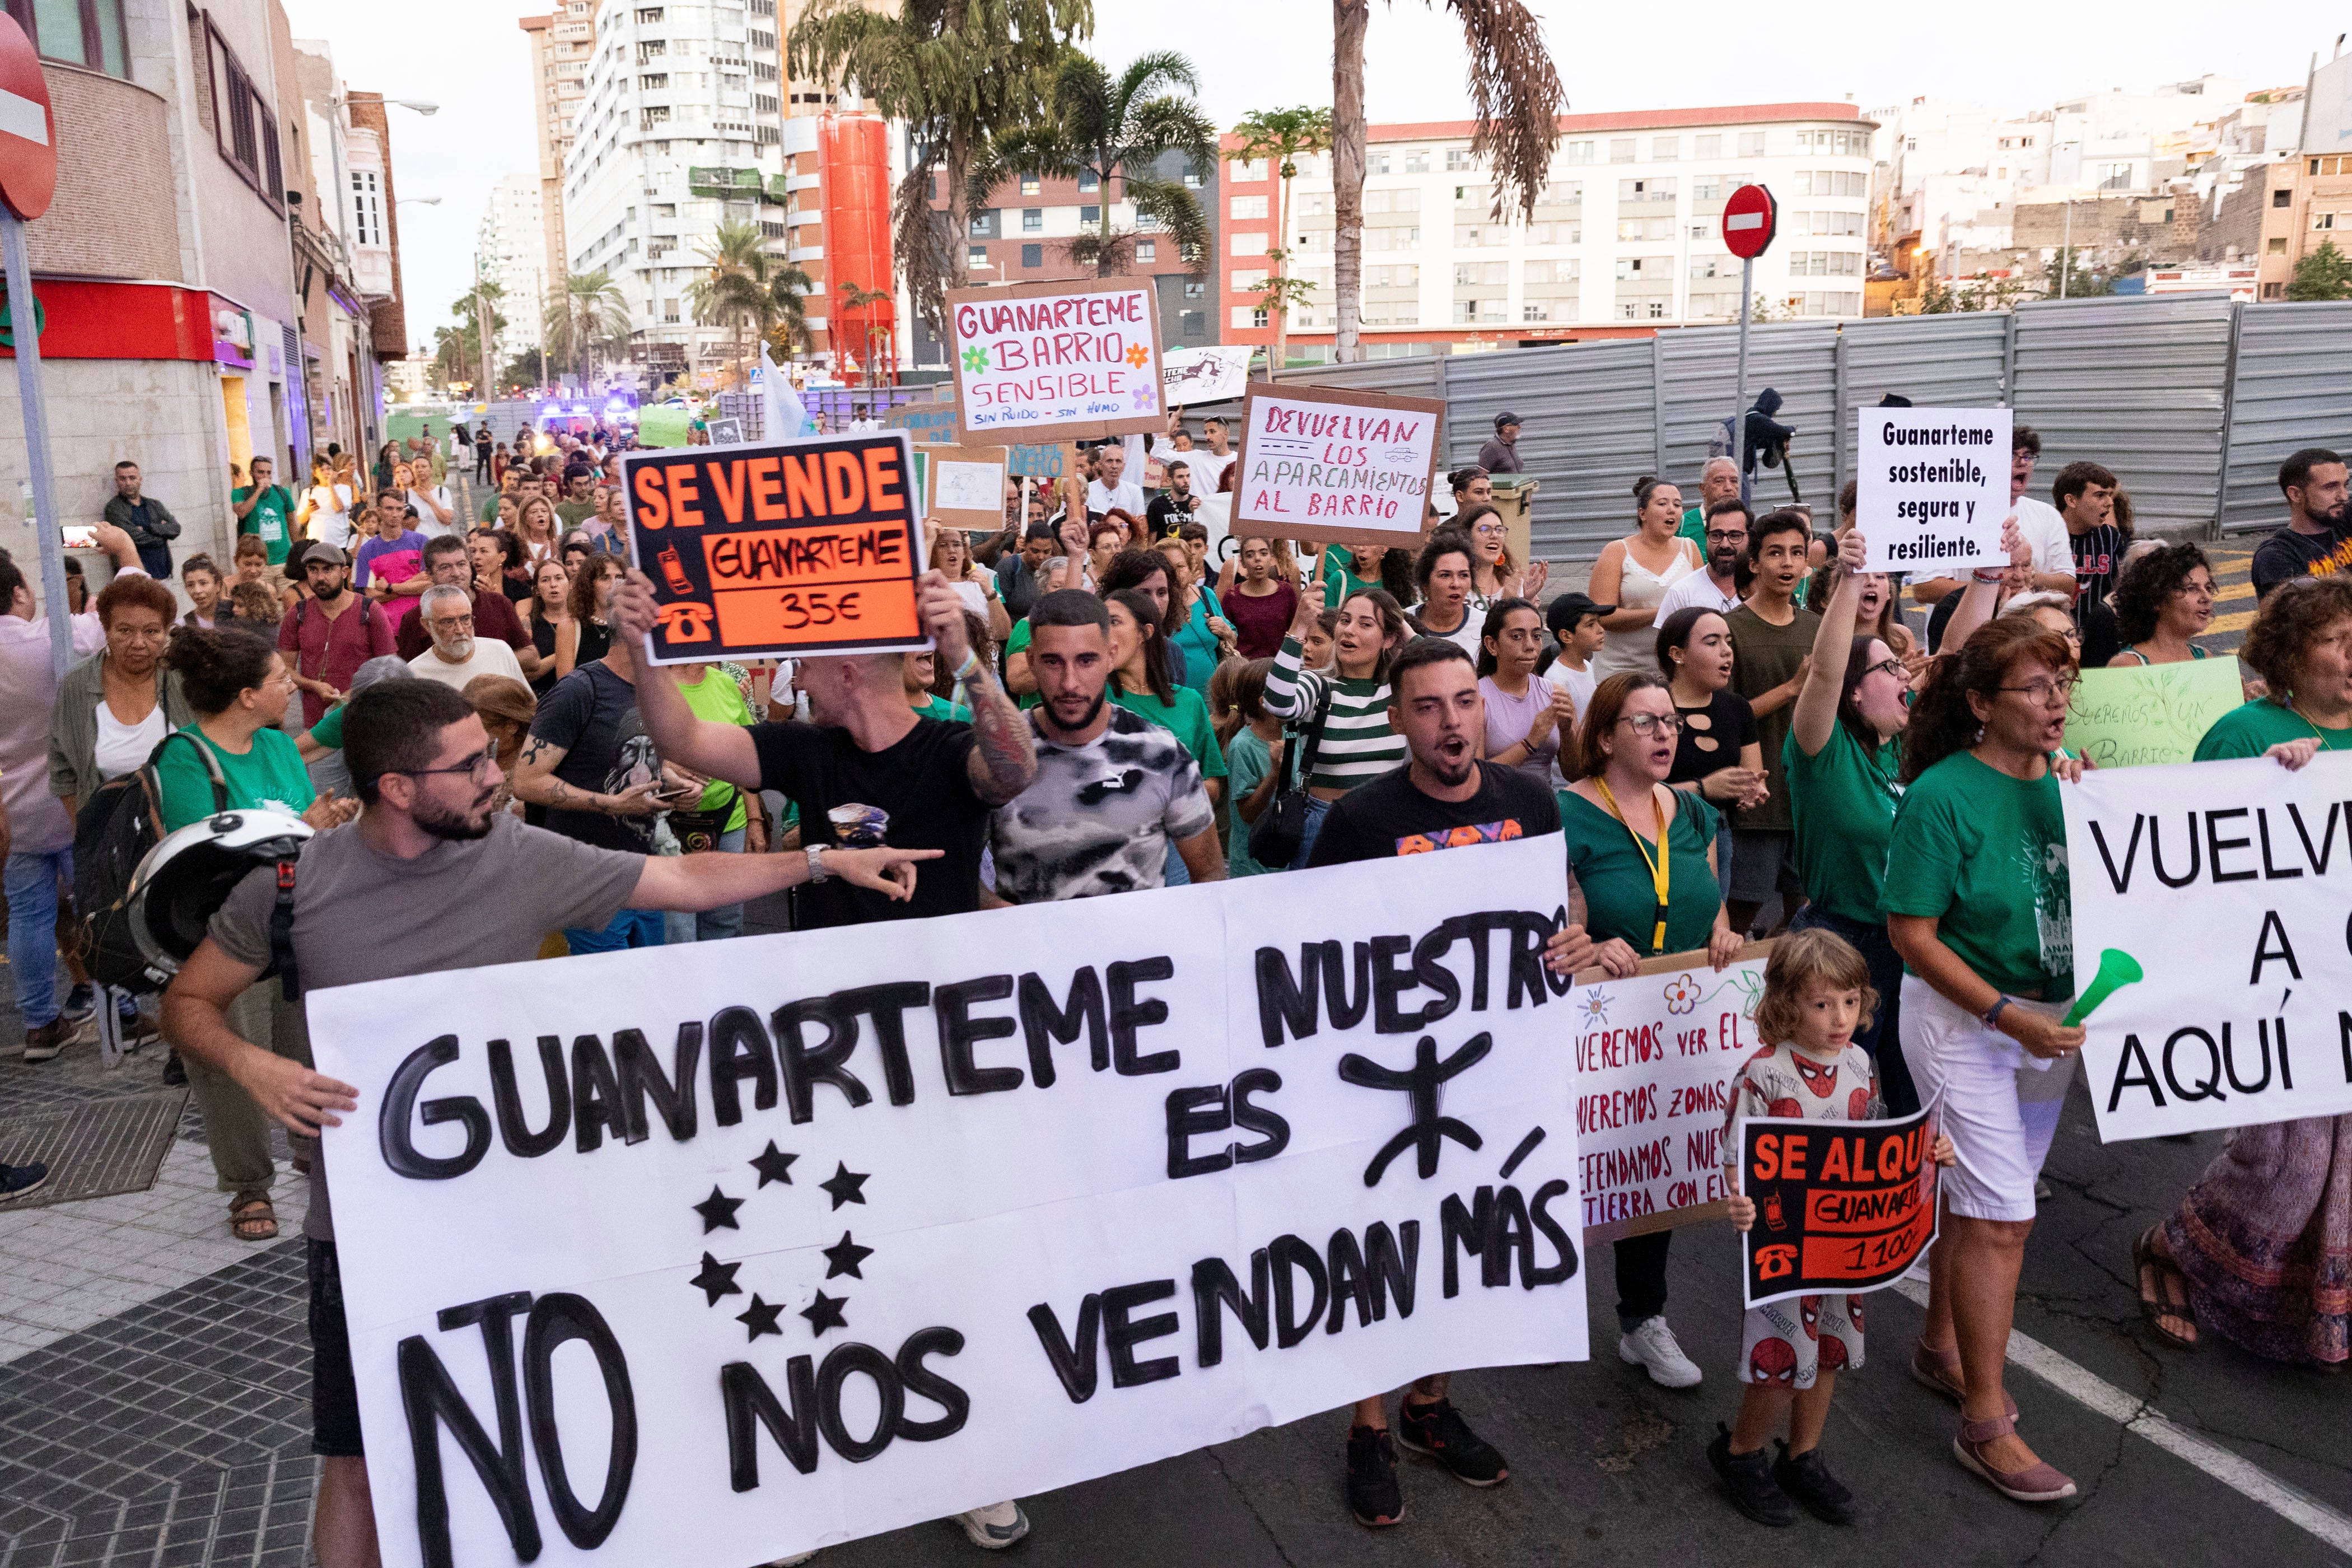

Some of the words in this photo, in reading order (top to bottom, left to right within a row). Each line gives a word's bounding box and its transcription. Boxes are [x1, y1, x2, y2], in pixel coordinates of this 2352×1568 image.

[957, 293, 1143, 339] GUANARTEME
[992, 332, 1123, 371] BARRIO
[972, 371, 1126, 407] SENSIBLE
[974, 412, 996, 424] SIN
[1001, 406, 1038, 421] RUIDO
[1055, 407, 1077, 417] SIN
[1086, 401, 1119, 414] HUMO
[1265, 406, 1418, 444] DEVUELVAN
[1883, 421, 1994, 446] Guanarteme
[1323, 443, 1368, 466] LOS
[1889, 458, 1986, 487] sostenible,
[635, 463, 705, 530] SE
[707, 446, 905, 524] VENDE
[1252, 461, 1427, 496] APARCAMIENTOS
[1254, 489, 1290, 512] AL
[1308, 493, 1398, 519] BARRIO
[1898, 500, 1959, 525] segura
[1966, 500, 1976, 524] y
[712, 528, 903, 581] GUANARTEME
[1888, 534, 1981, 560] resiliente.
[781, 592, 862, 629] 35€
[2087, 800, 2352, 895] VUELV
[2250, 910, 2303, 985] A
[378, 955, 1180, 1179] GUANARTEME
[1255, 904, 1573, 1048] NUESTRO
[1677, 1028, 1707, 1057] VER
[1719, 1012, 1743, 1050] EL
[2107, 987, 2293, 1113] AQUÍ
[1165, 1068, 1290, 1179] ES
[1576, 1083, 1657, 1136] UEREMOS
[1668, 1080, 1728, 1118] ZONAS
[1754, 1133, 1809, 1181] SE
[1583, 1188, 1655, 1226] TIERRA
[1667, 1178, 1698, 1208] CON
[1706, 1173, 1729, 1203] EL
[398, 1290, 638, 1568] NO
[721, 1327, 970, 1494] NOS
[1026, 1220, 1420, 1405] VENDAN
[1440, 1126, 1578, 1299] MÁS
